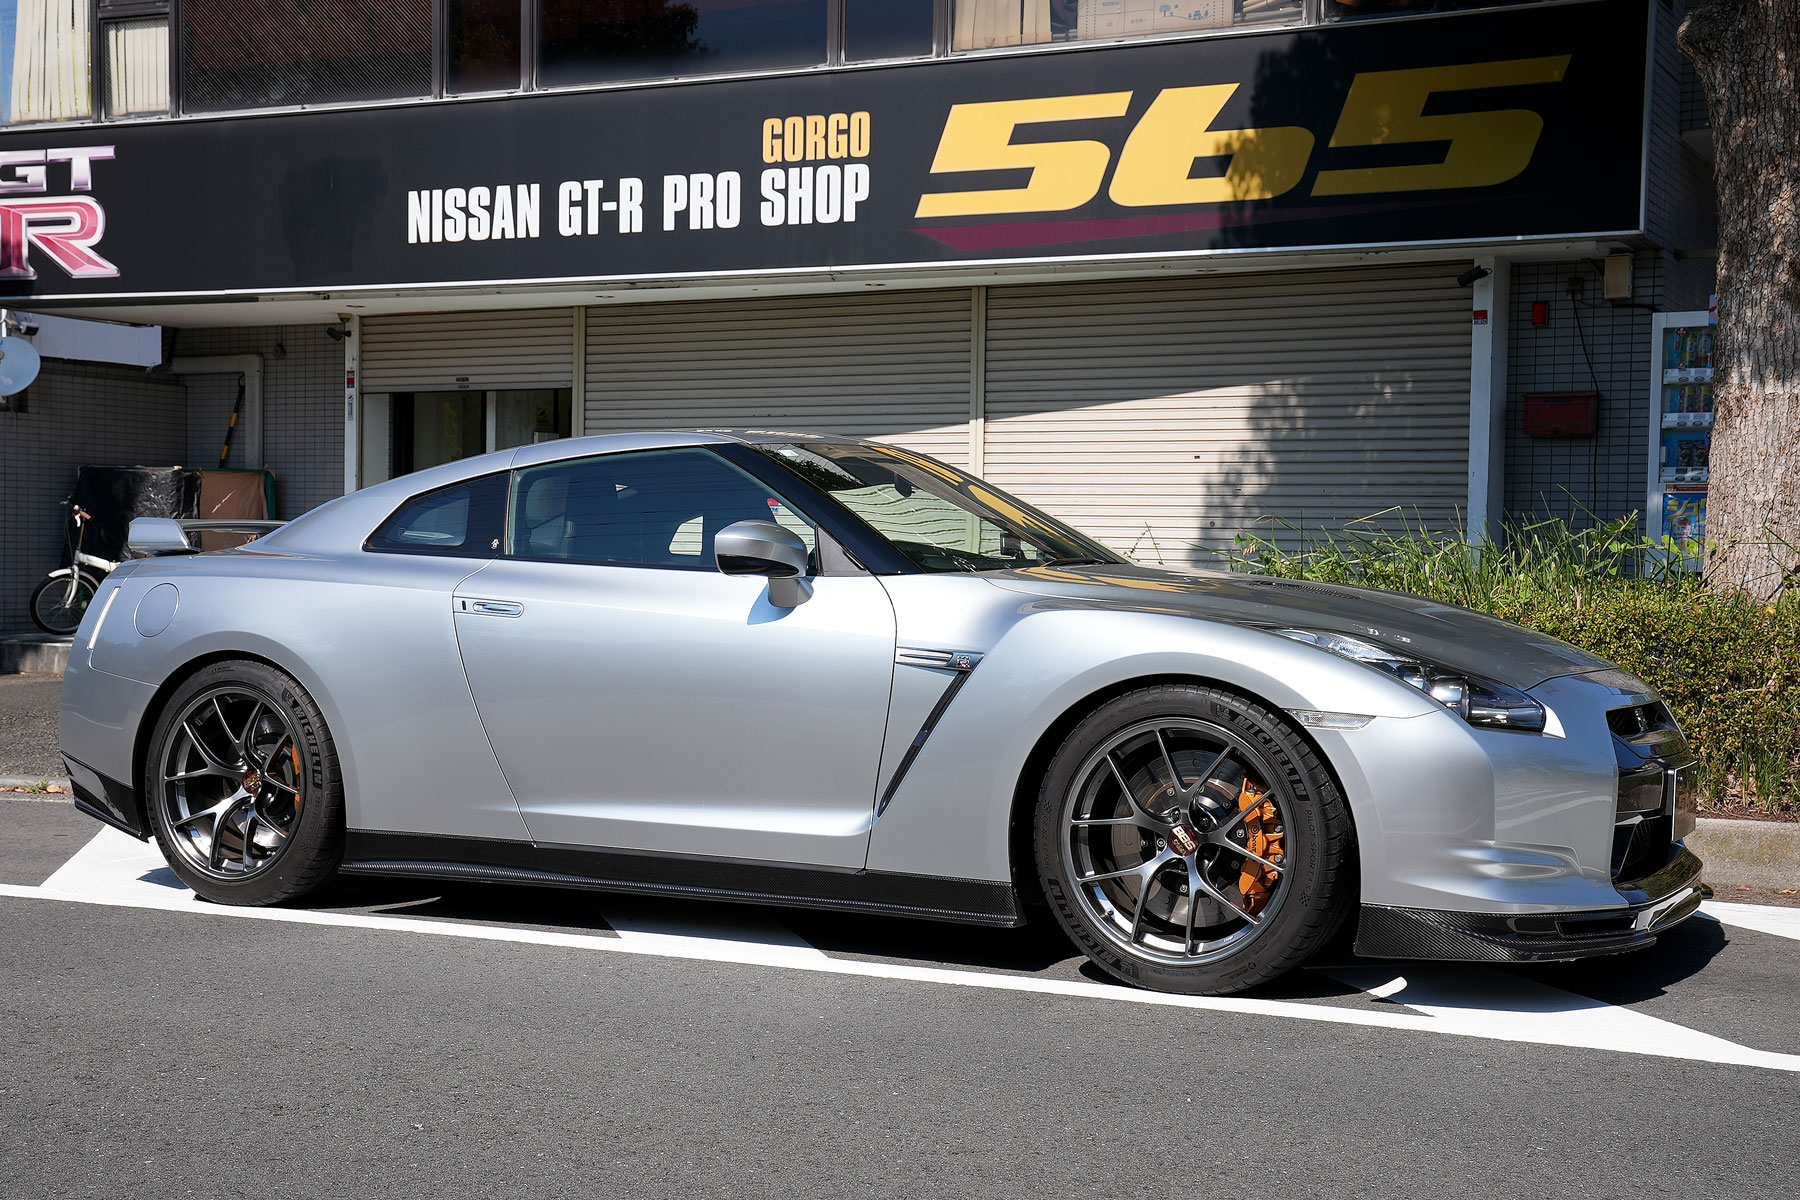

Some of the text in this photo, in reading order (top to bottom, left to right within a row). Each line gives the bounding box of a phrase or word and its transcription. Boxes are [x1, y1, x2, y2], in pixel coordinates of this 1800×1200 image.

[762, 110, 871, 164] GORGO
[914, 54, 1572, 219] 565
[407, 163, 871, 244] NISSAN GT-R PRO SHOP
[294, 705, 323, 787] MICHELIN
[1234, 715, 1308, 798] MICHELIN
[1172, 825, 1197, 851] BBS
[1305, 809, 1316, 838] PILOT
[1308, 842, 1317, 876] SPORT
[1050, 881, 1118, 966] MICHELIN
